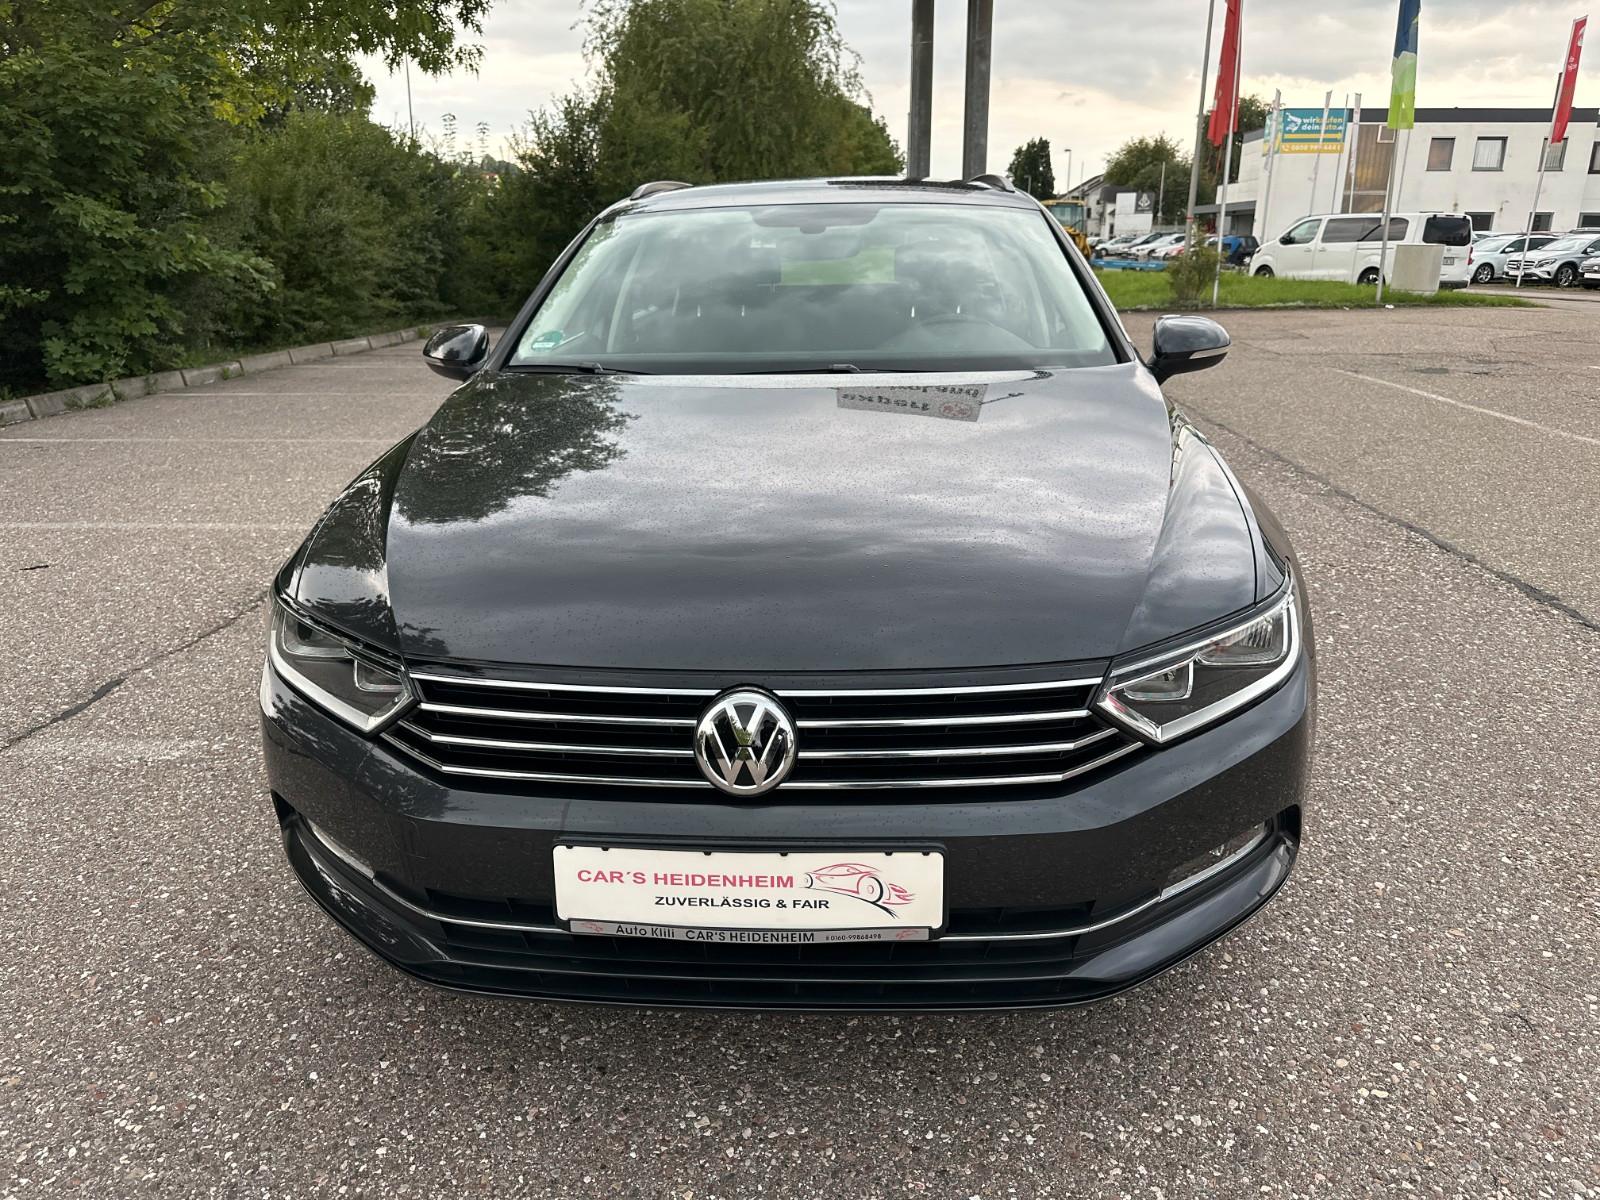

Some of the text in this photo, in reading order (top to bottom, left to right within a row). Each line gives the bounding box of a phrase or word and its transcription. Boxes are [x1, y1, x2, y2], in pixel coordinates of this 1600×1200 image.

[653, 872, 794, 888] HEIDENHEIM
[654, 896, 830, 909] ZUVERLÄSSIG & FAIR
[616, 924, 648, 937] Auto
[729, 931, 815, 943] HEIDENHEIM
